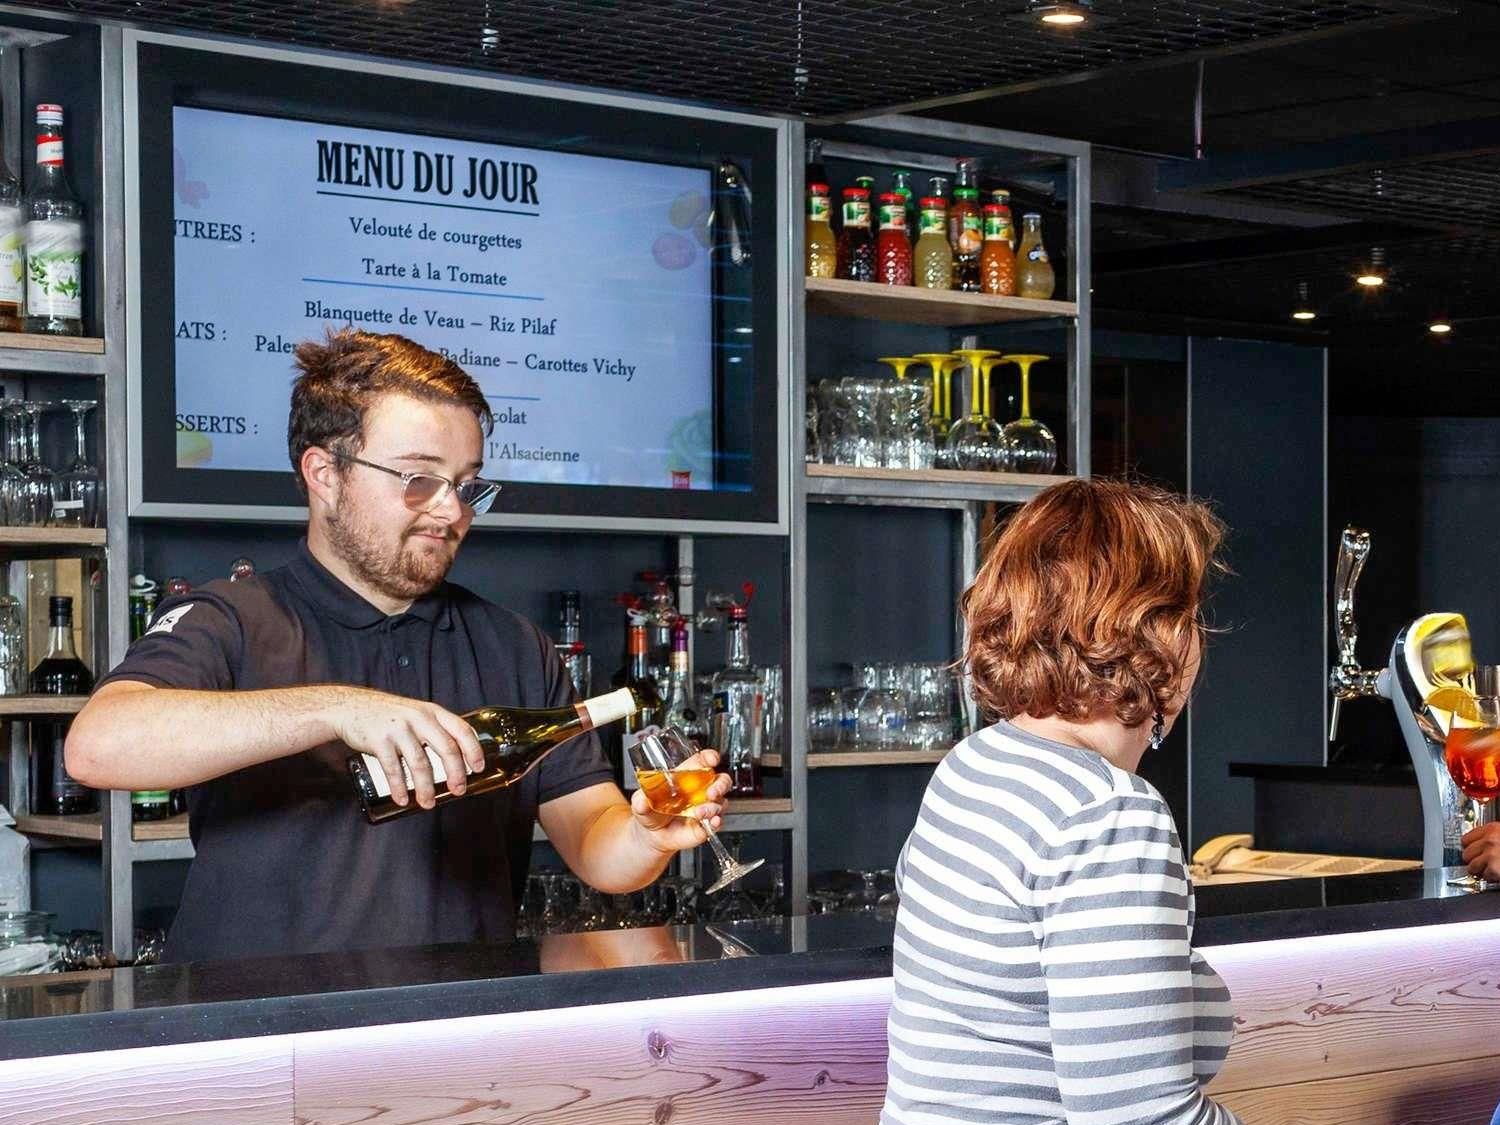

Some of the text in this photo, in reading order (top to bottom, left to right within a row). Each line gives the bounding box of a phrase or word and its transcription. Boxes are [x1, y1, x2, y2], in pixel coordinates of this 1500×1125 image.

[316, 139, 540, 205] MENU DU JOUR
[349, 216, 522, 252] Velouté de courgettes
[362, 258, 508, 287] Tarte à la Tomate
[304, 300, 393, 327] Blanquette
[399, 307, 418, 325] de
[424, 310, 465, 329] Veau
[489, 315, 516, 333] Riz
[521, 317, 558, 336] Pilaf
[524, 353, 589, 374] Carottes
[592, 358, 637, 382] Vichy
[488, 441, 580, 463] l'Alsacienne
